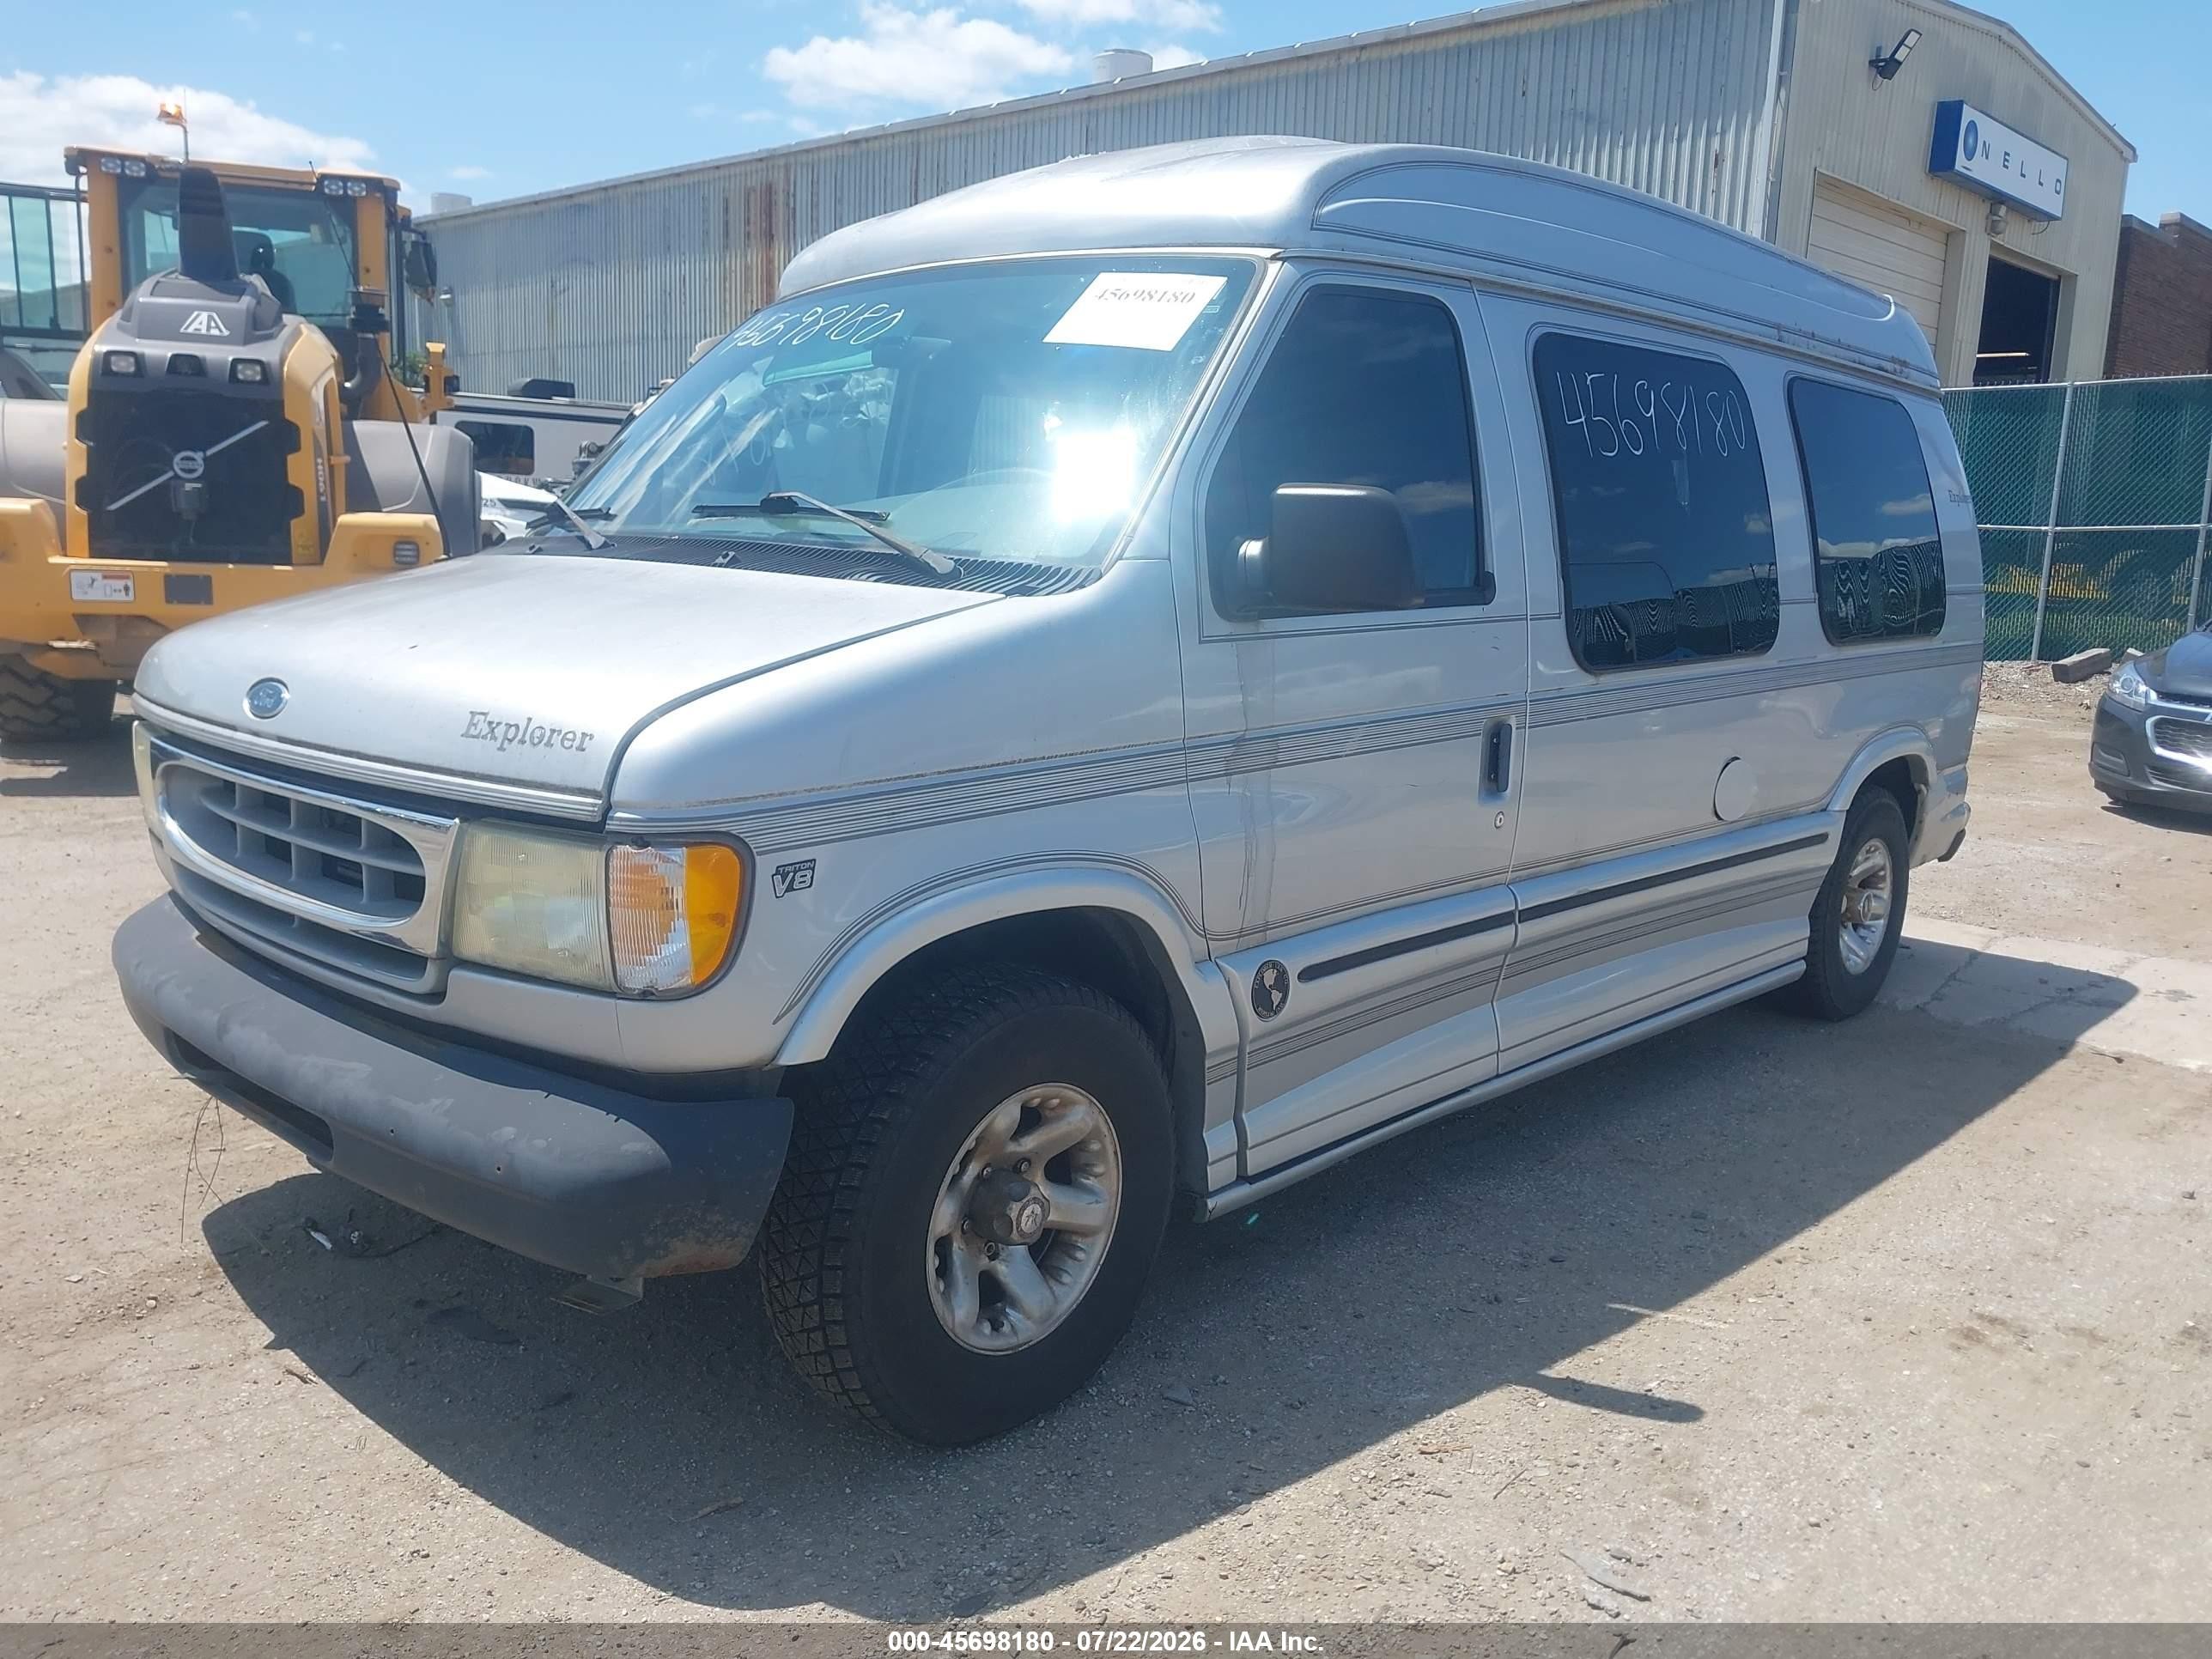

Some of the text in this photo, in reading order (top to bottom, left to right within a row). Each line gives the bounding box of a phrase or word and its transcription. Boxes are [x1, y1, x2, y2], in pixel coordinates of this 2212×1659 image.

[1095, 288, 1195, 304] 45698180
[1555, 371, 1746, 458] 45698180
[460, 711, 594, 752] Explorer
[777, 860, 815, 874] TRITON
[773, 869, 812, 896] V8
